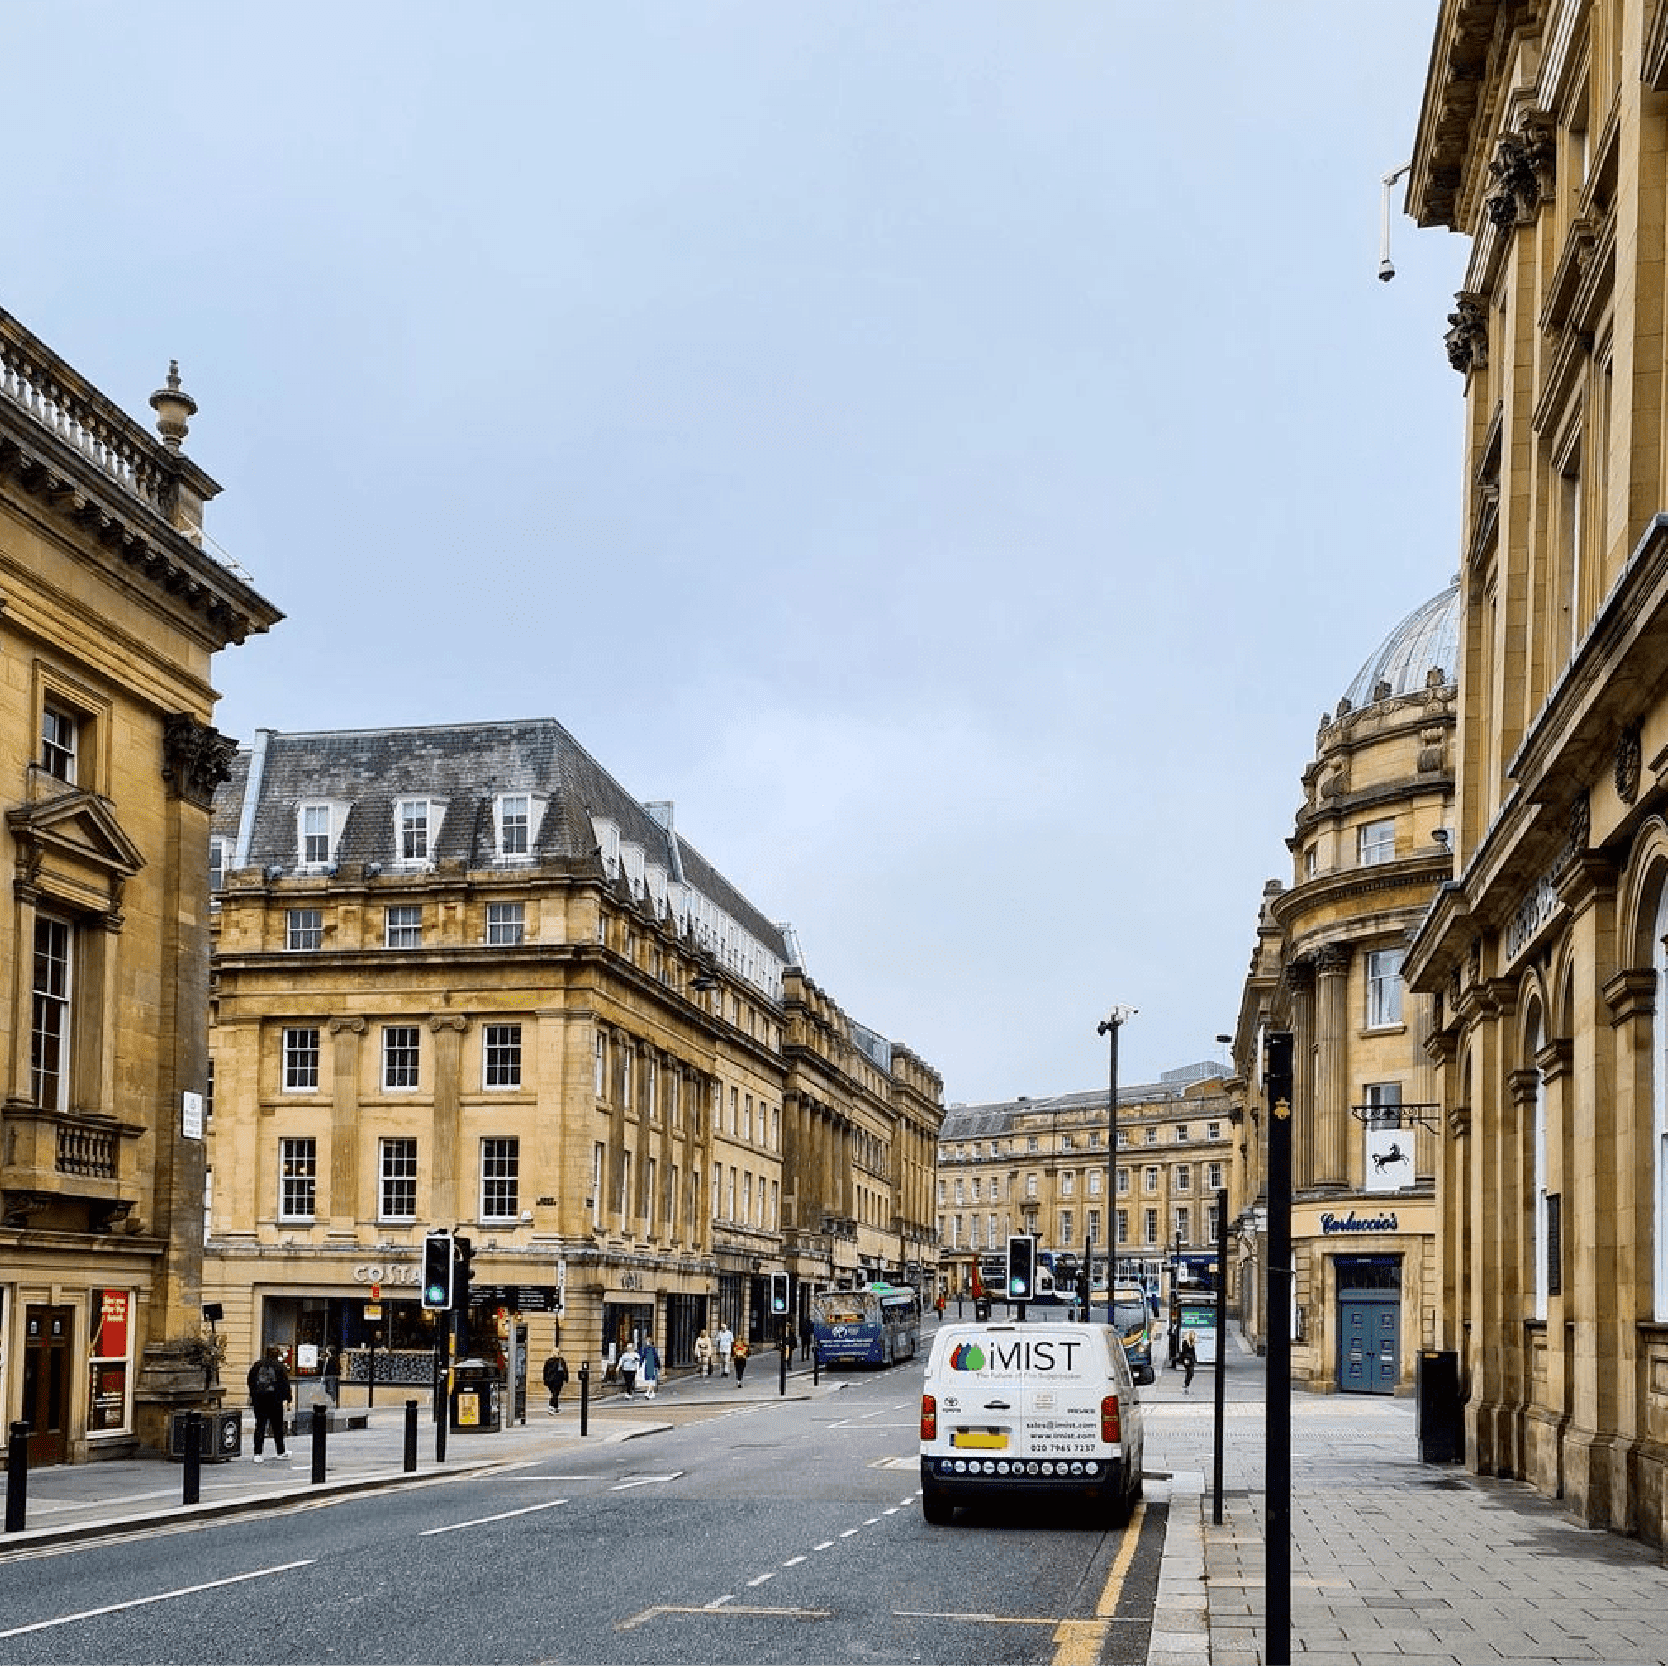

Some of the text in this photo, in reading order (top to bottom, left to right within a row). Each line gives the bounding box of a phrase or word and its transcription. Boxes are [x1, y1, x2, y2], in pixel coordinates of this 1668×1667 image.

[1321, 1211, 1397, 1234] Carluccio's
[990, 1342, 1081, 1371] iMIST
[1026, 1420, 1097, 1430] sales@imist.com
